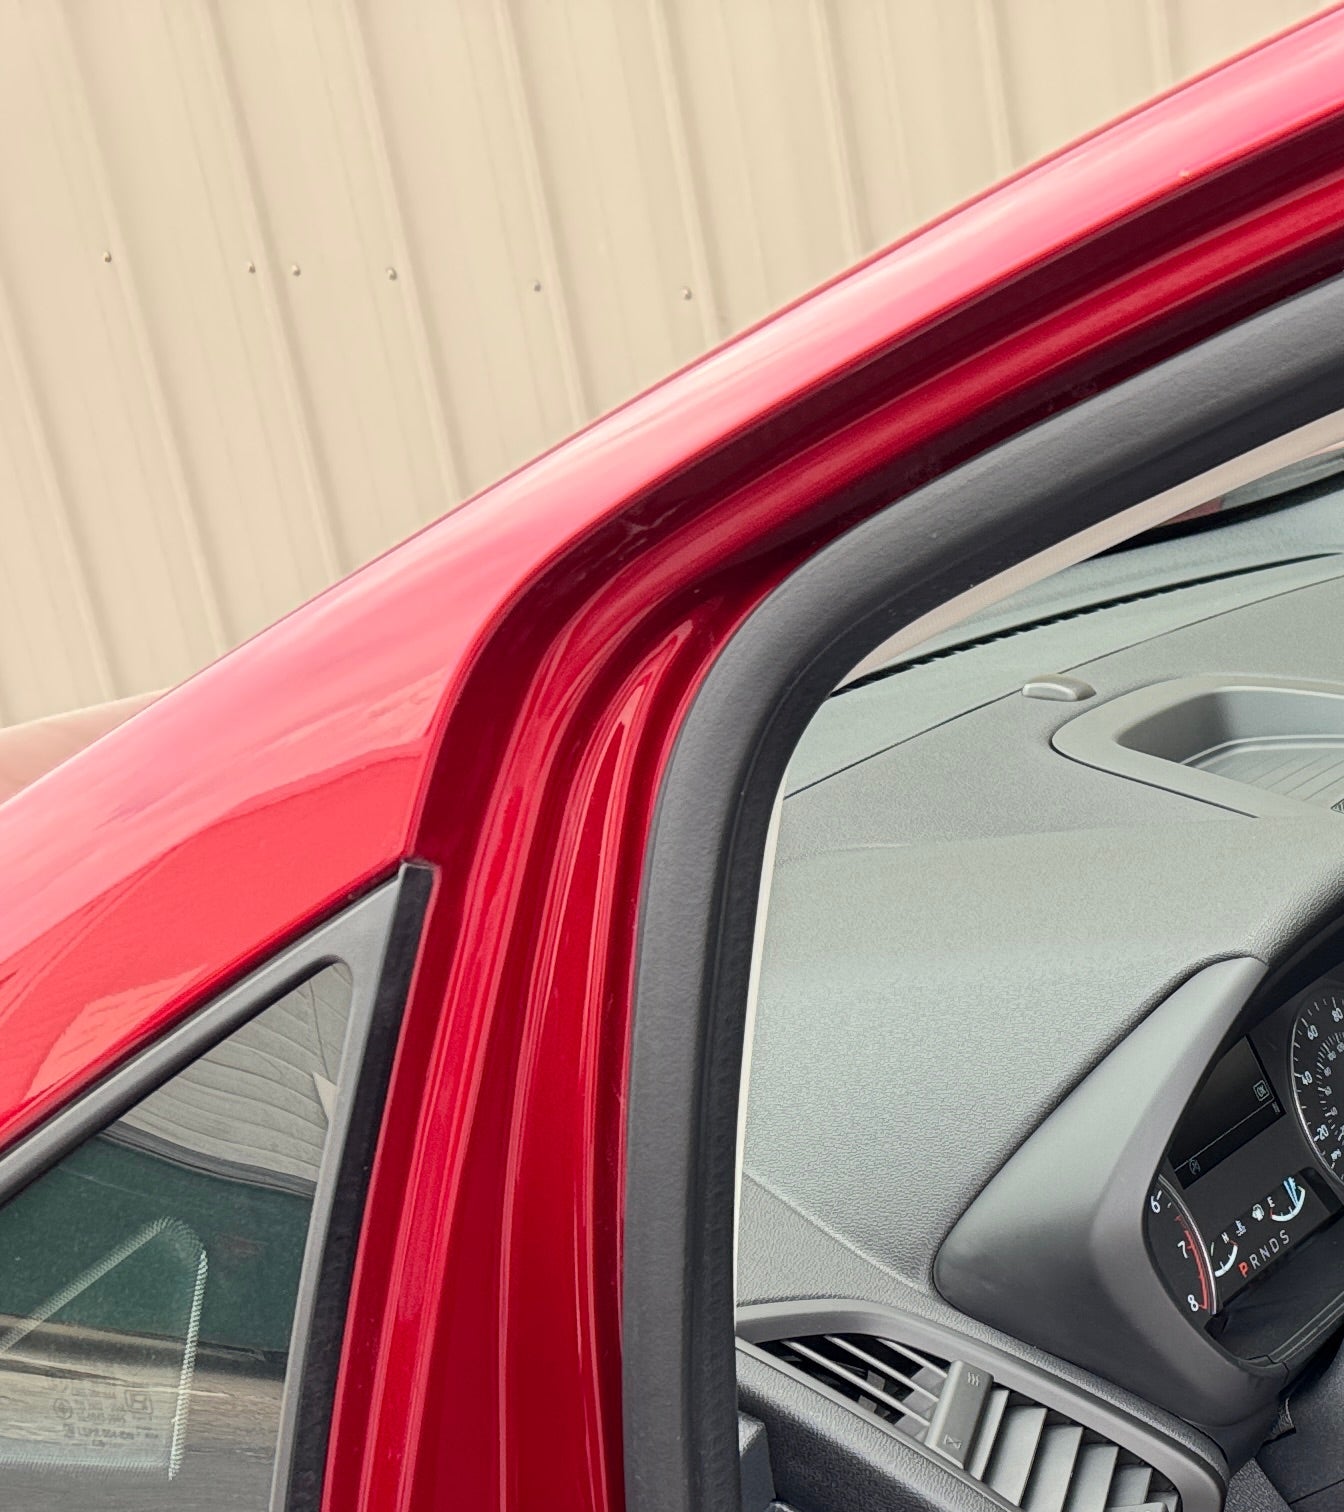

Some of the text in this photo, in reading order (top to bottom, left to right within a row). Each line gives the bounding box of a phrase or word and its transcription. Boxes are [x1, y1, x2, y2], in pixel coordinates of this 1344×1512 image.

[1332, 1008, 1344, 1022] 80
[1307, 1025, 1318, 1040] 60
[1301, 1071, 1313, 1086] 40
[1317, 1124, 1329, 1140] 20
[1150, 1195, 1161, 1214] 6
[1177, 1240, 1188, 1259] 7
[1187, 1294, 1199, 1312] 8
